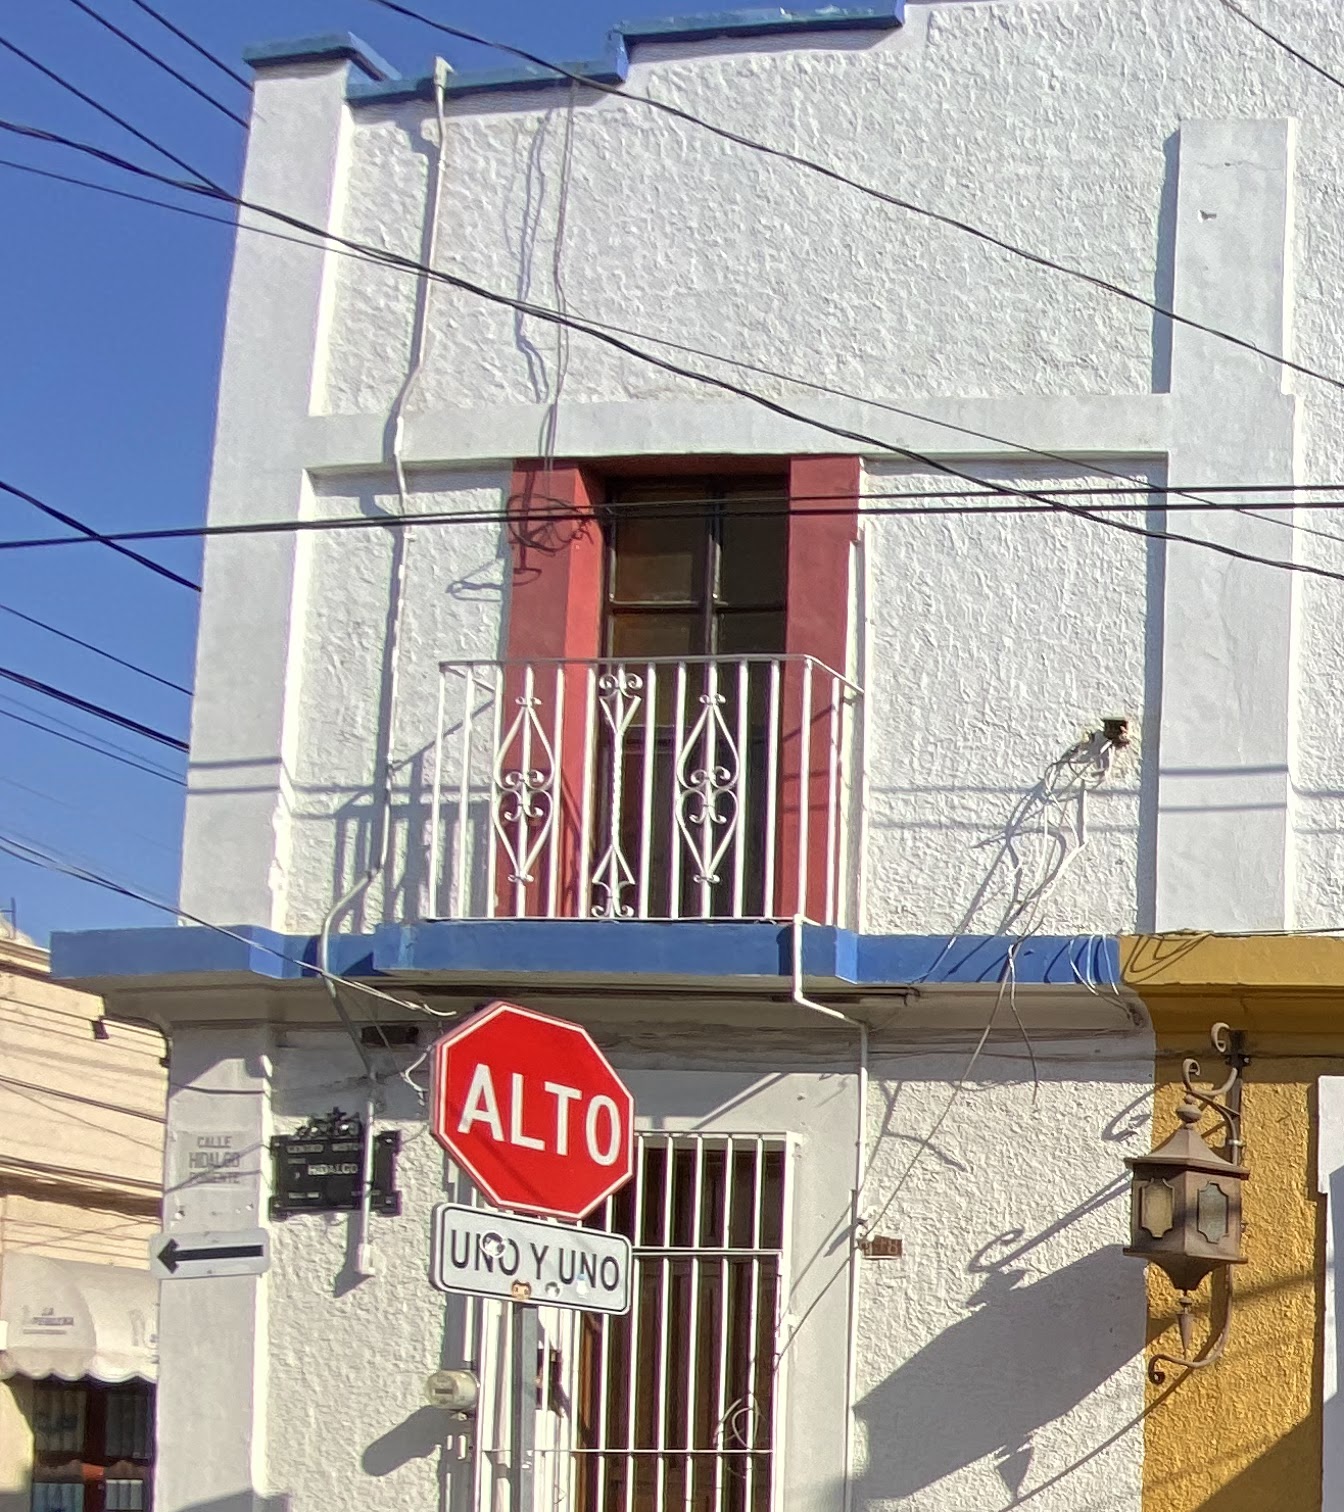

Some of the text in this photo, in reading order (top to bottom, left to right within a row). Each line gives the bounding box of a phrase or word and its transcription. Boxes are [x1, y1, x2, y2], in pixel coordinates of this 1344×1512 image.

[457, 1063, 621, 1166] ALTO
[197, 1136, 232, 1148] CALLE
[308, 1164, 358, 1175] HIDALGO
[451, 1228, 619, 1292] UNO Y UNO
